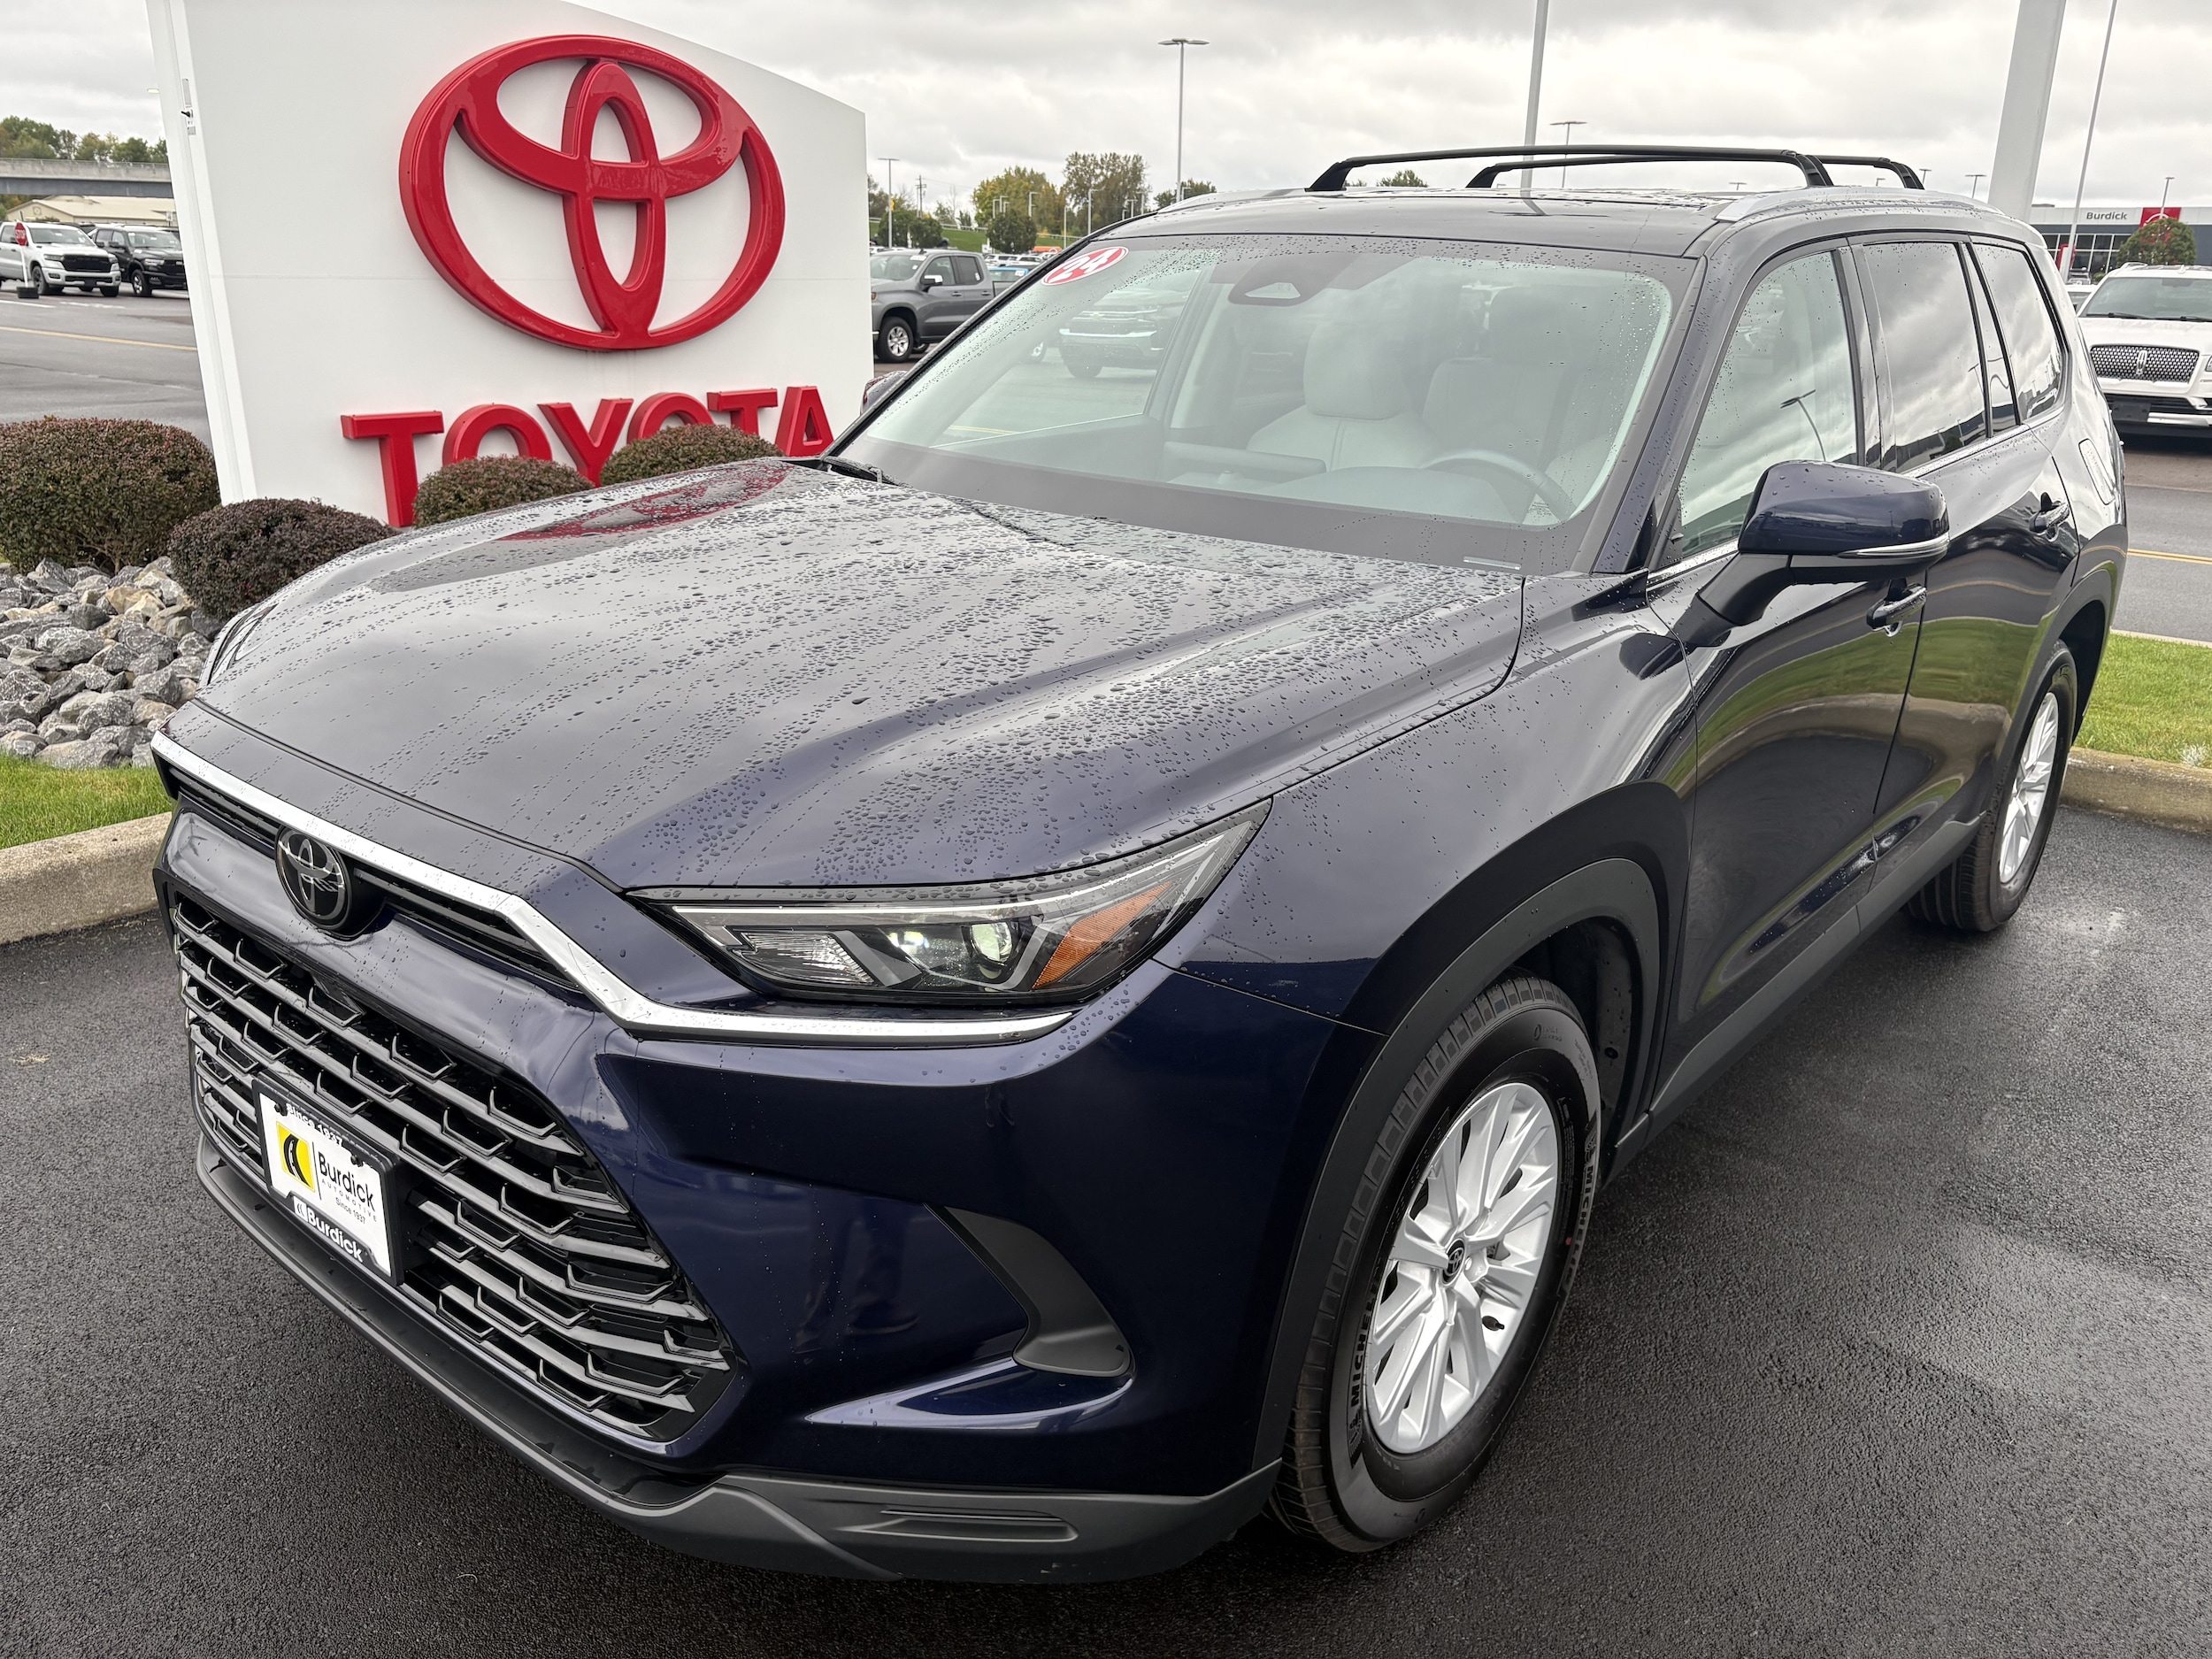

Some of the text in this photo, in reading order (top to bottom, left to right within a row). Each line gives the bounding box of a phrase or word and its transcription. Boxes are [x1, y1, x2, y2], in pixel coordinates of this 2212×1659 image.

[2086, 211, 2128, 220] Burdick
[1048, 248, 1122, 283] 24
[318, 1151, 376, 1212] Burdick
[321, 1179, 377, 1222] AUTOMOTIVE
[335, 1196, 366, 1225] Since 1937
[307, 1207, 364, 1263] Burdick
